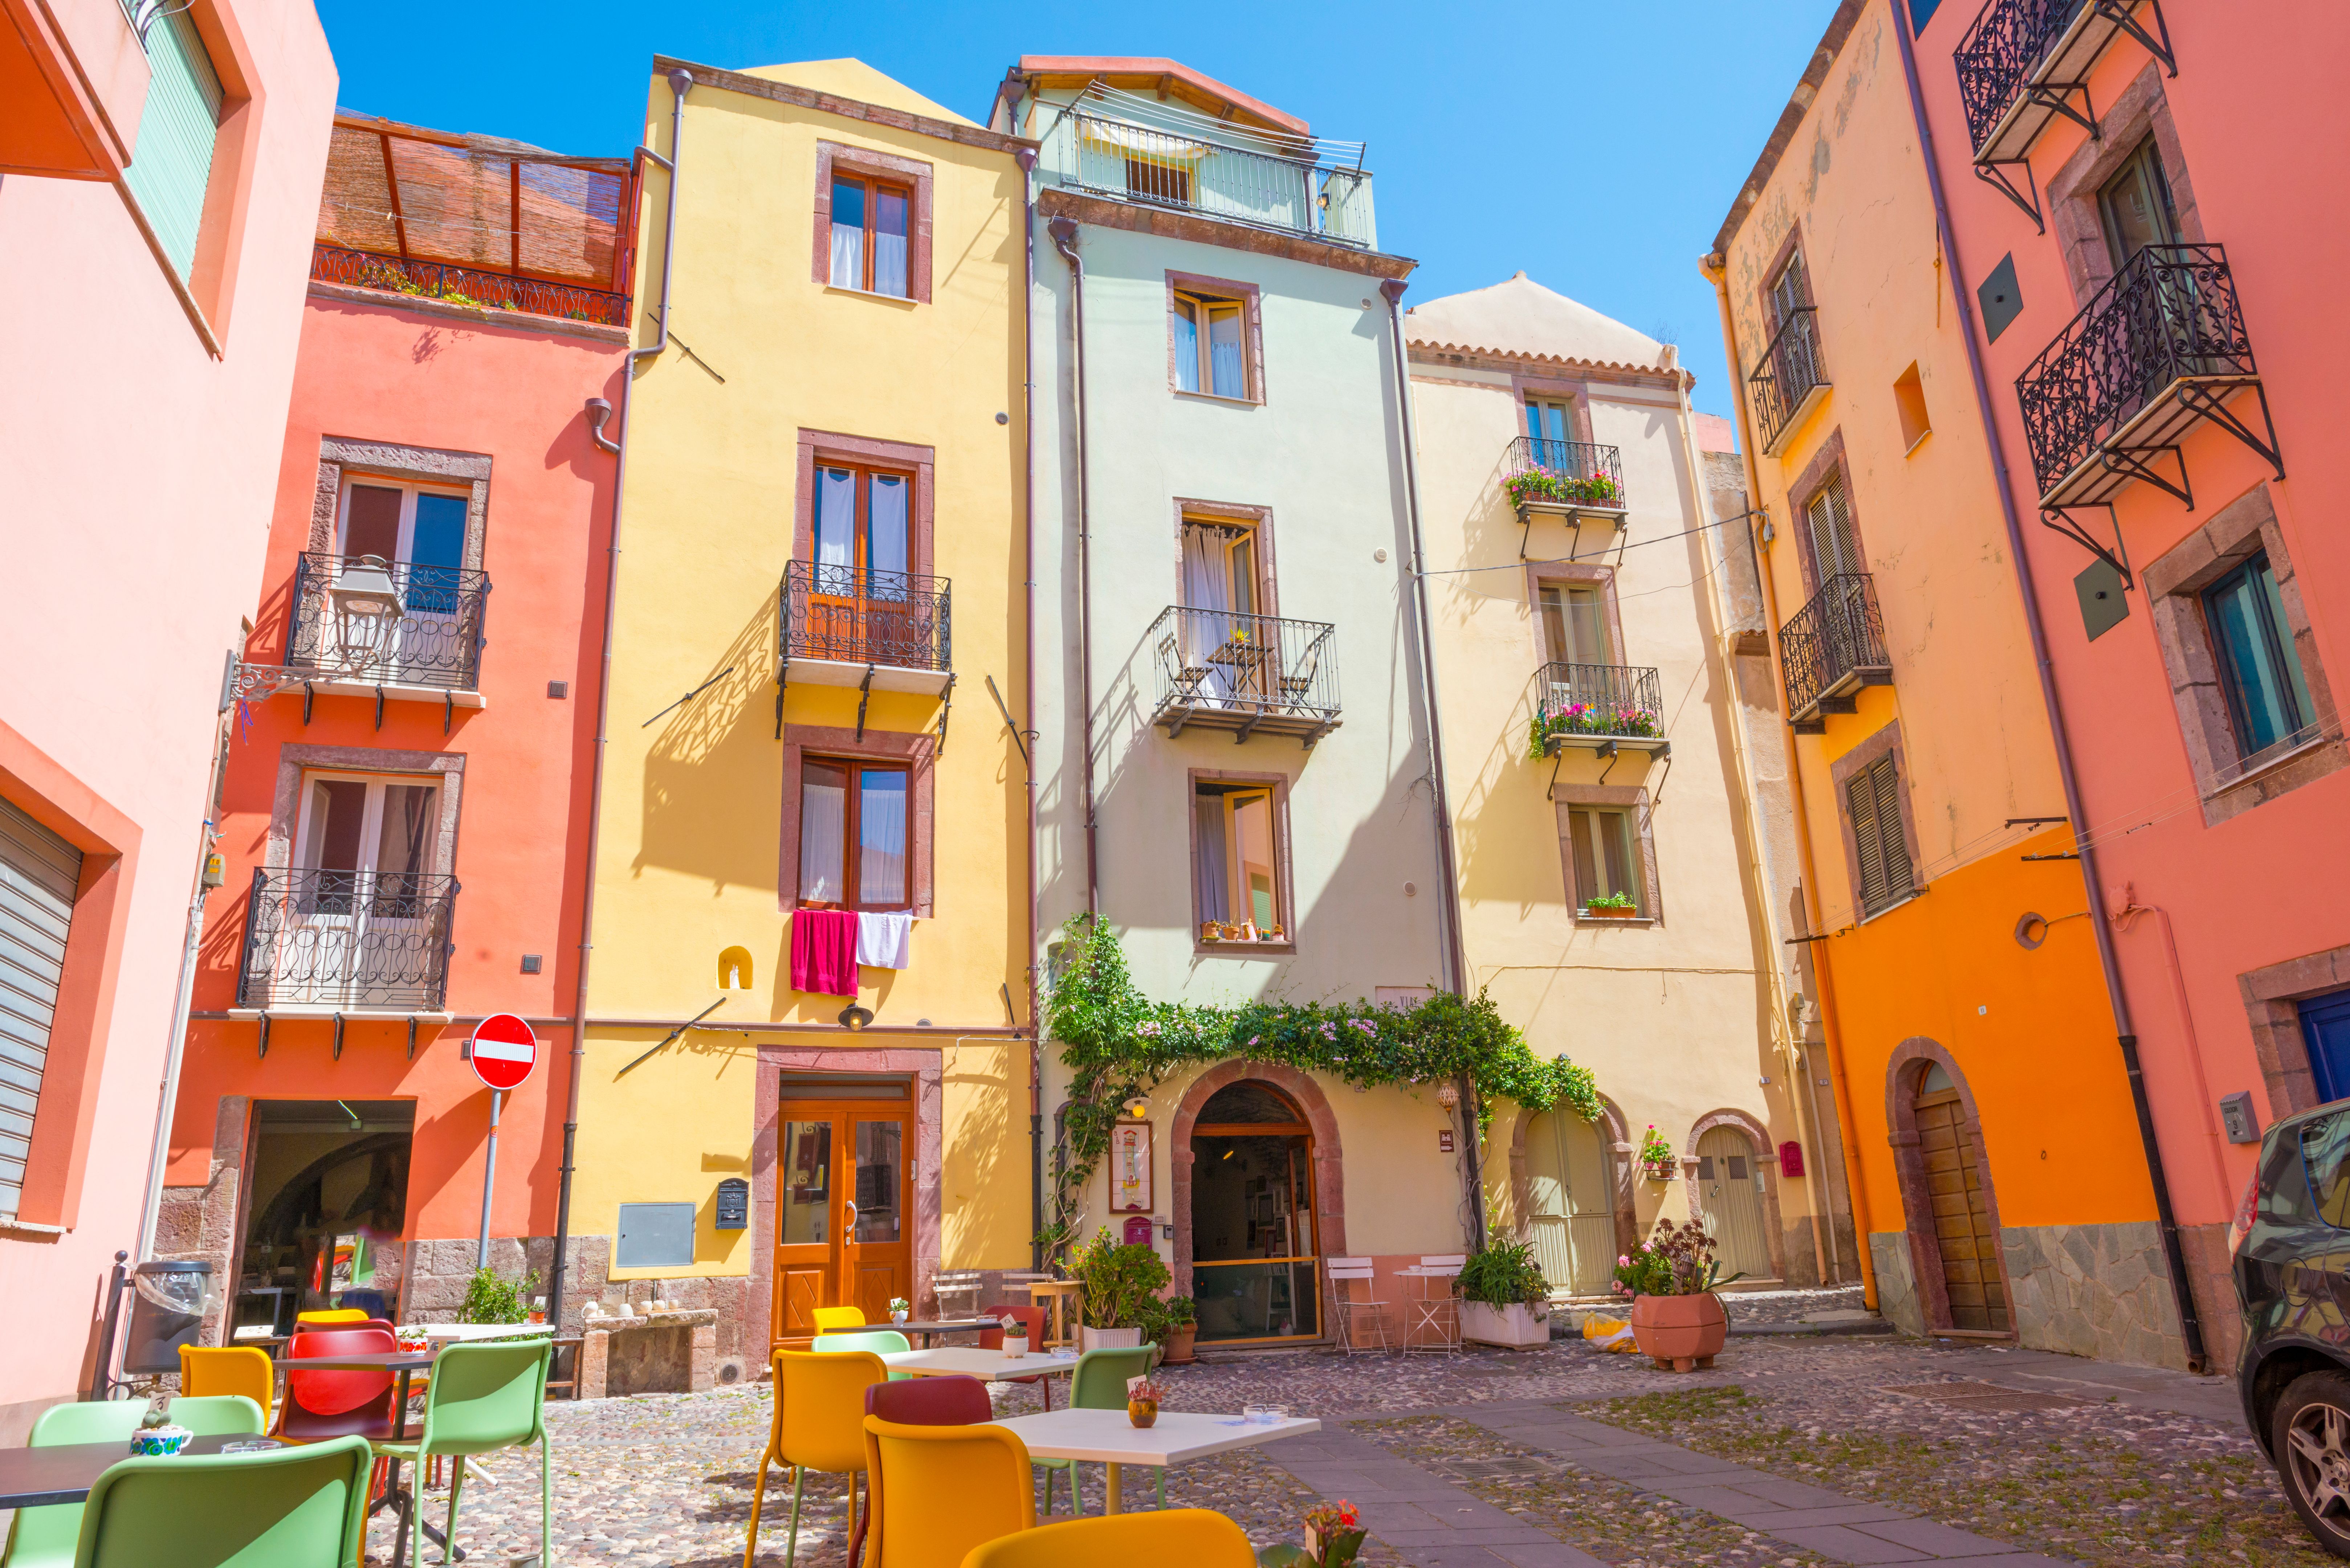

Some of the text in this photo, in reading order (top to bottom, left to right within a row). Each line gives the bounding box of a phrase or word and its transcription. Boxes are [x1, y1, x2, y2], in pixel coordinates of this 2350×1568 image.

[1400, 996, 1414, 1006] VIA
[2233, 1120, 2238, 1129] 9
[155, 1396, 166, 1410] 3
